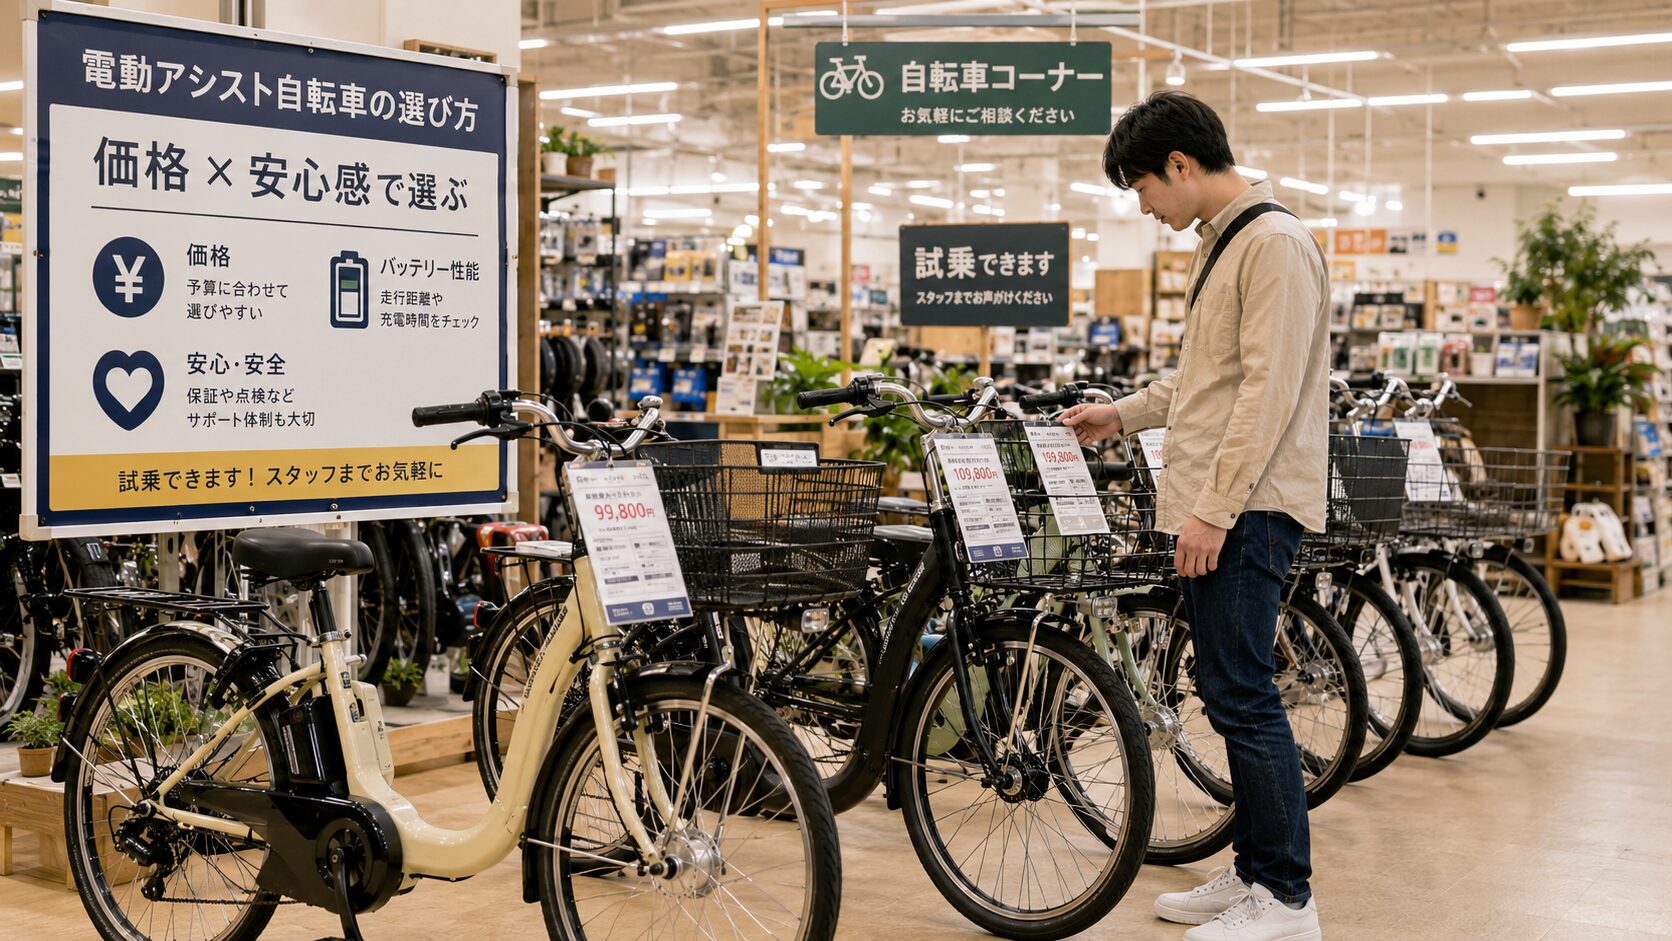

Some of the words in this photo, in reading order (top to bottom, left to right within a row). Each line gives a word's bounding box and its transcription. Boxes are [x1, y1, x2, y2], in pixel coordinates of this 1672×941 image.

[901, 59, 1104, 94] 自転車コーナー
[82, 48, 479, 133] 電動アシスト自転車の選び方
[900, 106, 1075, 125] お気軽にご相談ください
[93, 135, 190, 193] 価格
[249, 151, 469, 212] 安心感で選ぶ
[186, 242, 231, 268] 価格
[914, 245, 1055, 280] 試乗できます
[380, 256, 480, 282] バッテリー性能
[186, 278, 289, 299] 予算に合わせて
[380, 289, 443, 307] 走行距離や
[916, 289, 1053, 305] スタッフまでお声がけください
[186, 302, 263, 321] 選びやすい
[380, 311, 480, 329] 充電時間をチェック
[187, 351, 286, 376] 安心・安全
[186, 387, 295, 405] 保証や点検など
[186, 411, 315, 428] サポート体制も大切
[266, 460, 443, 486] スタッフまでお気軽に
[953, 467, 998, 482] 109,800円
[594, 502, 655, 522] 99,800円
